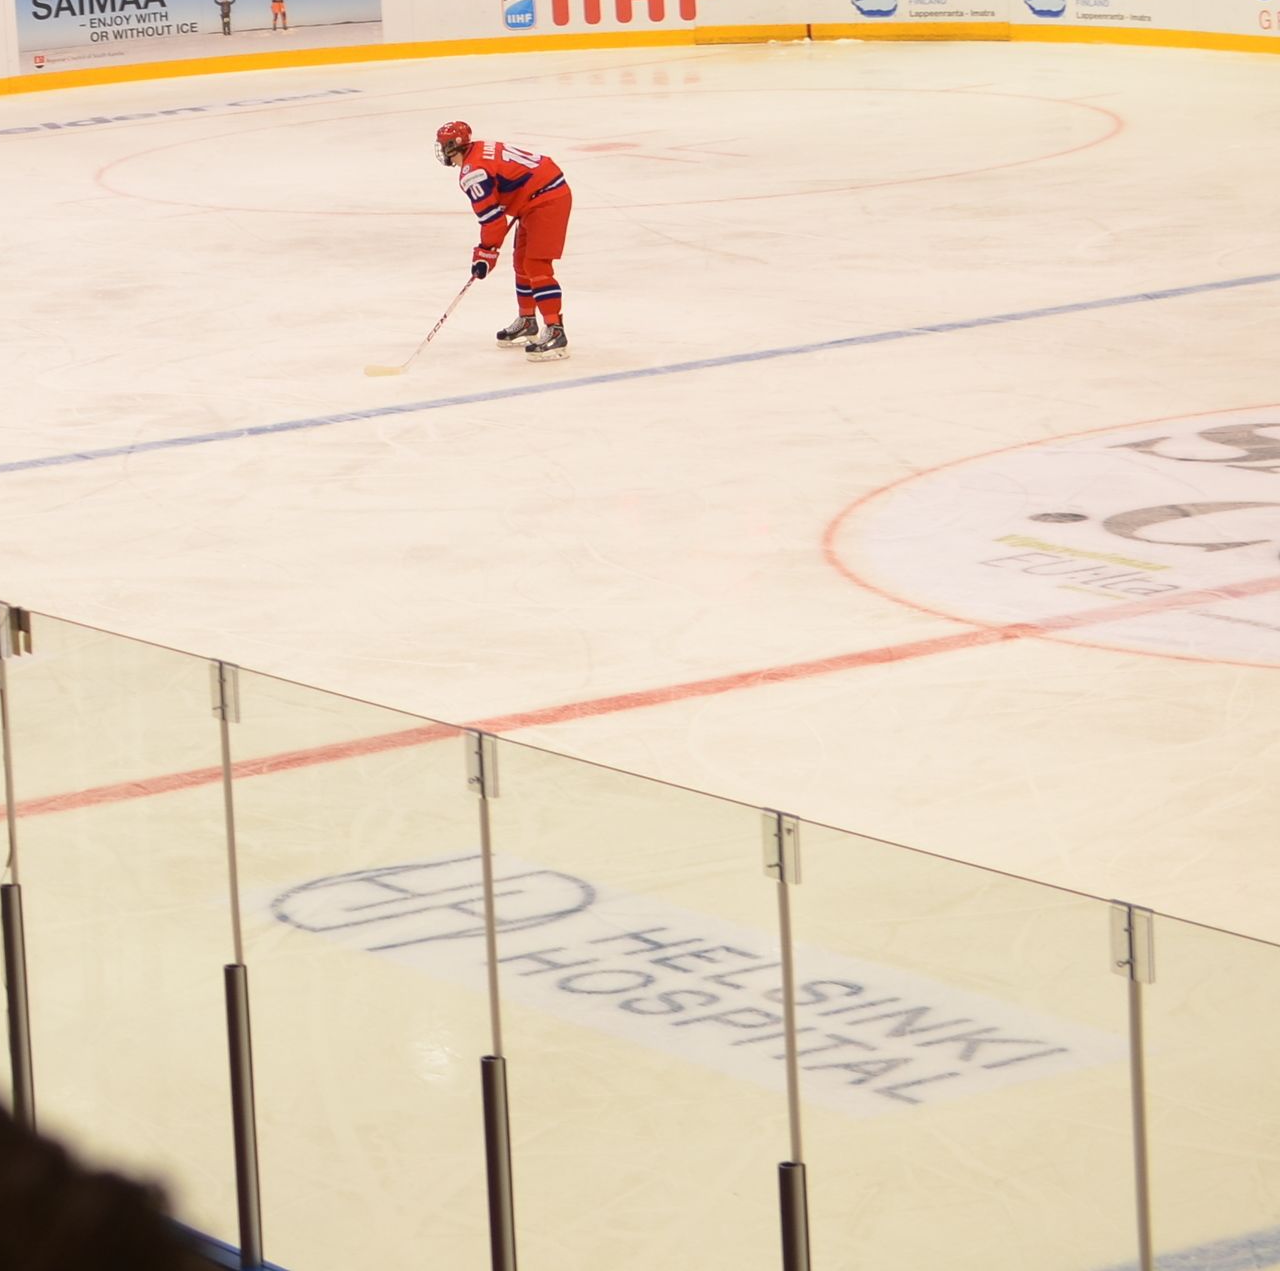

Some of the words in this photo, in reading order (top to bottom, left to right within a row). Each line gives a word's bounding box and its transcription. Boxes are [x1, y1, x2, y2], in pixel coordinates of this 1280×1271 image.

[90, 13, 133, 29] ENJOY
[135, 11, 168, 25] WITH
[507, 13, 533, 24] IIHF
[909, 9, 964, 19] Lappeenranta
[90, 30, 110, 43] OR
[112, 25, 173, 40] WITHOUT
[177, 22, 199, 34] ICE
[469, 183, 485, 201] 10
[587, 926, 1071, 1071] HELSINKI
[492, 946, 961, 1105] HOSPITAL
